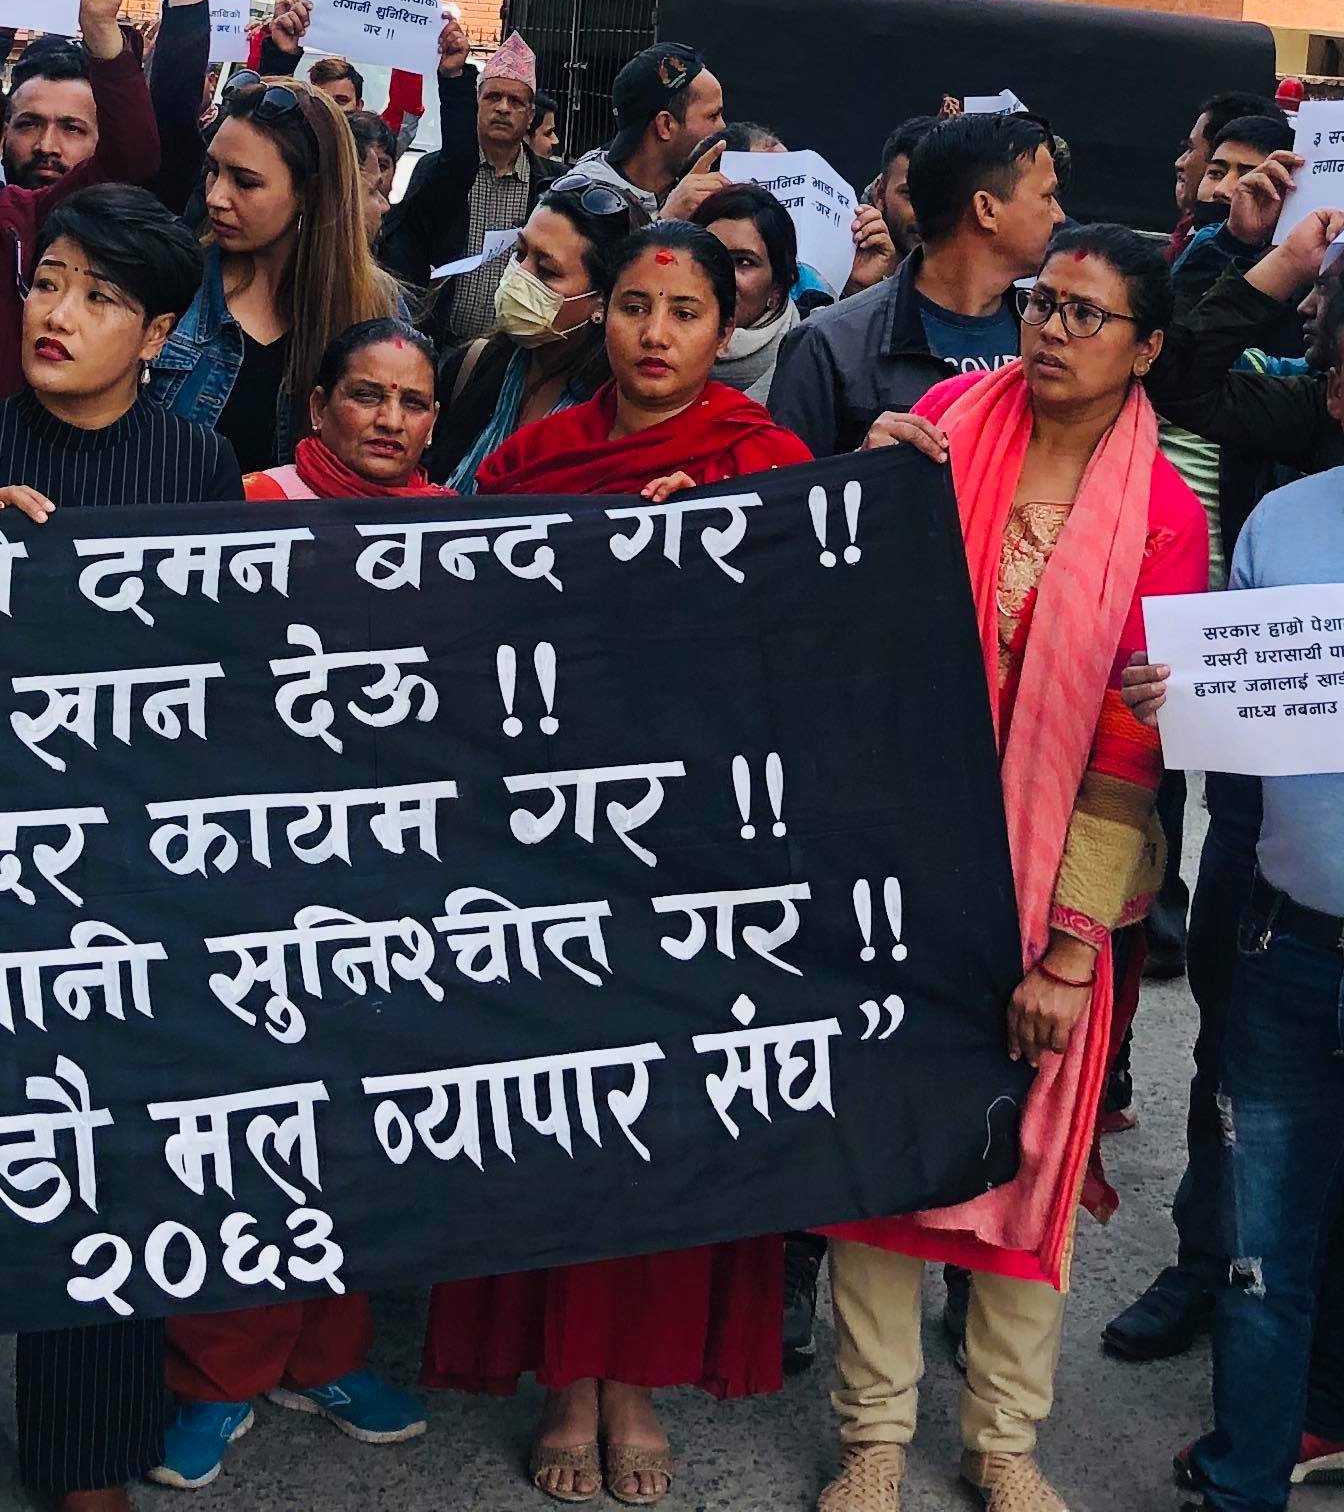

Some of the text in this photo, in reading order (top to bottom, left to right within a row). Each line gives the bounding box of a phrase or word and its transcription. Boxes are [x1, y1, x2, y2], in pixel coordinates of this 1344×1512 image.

[363, 23, 381, 36] गर
[74, 527, 314, 627] दमन
[354, 513, 573, 594] बन्द
[606, 491, 763, 584] गर
[808, 480, 863, 567] !!
[1203, 622, 1261, 640] सरकार
[1203, 648, 1247, 667] यसरी
[1255, 643, 1322, 664] धरासायी
[10, 661, 225, 773] खान
[268, 624, 441, 753] देऊ
[495, 641, 559, 738] !!
[1194, 678, 1237, 698] हजार
[1244, 673, 1309, 693] जनालाई
[145, 781, 459, 879] कायम
[503, 761, 687, 869] गर
[730, 752, 788, 839] !!
[652, 881, 810, 976] गर
[852, 877, 910, 963] !!
[147, 1080, 330, 1205] मल
[362, 1042, 664, 1172] व्यापार
[67, 1207, 345, 1316] २०६३
